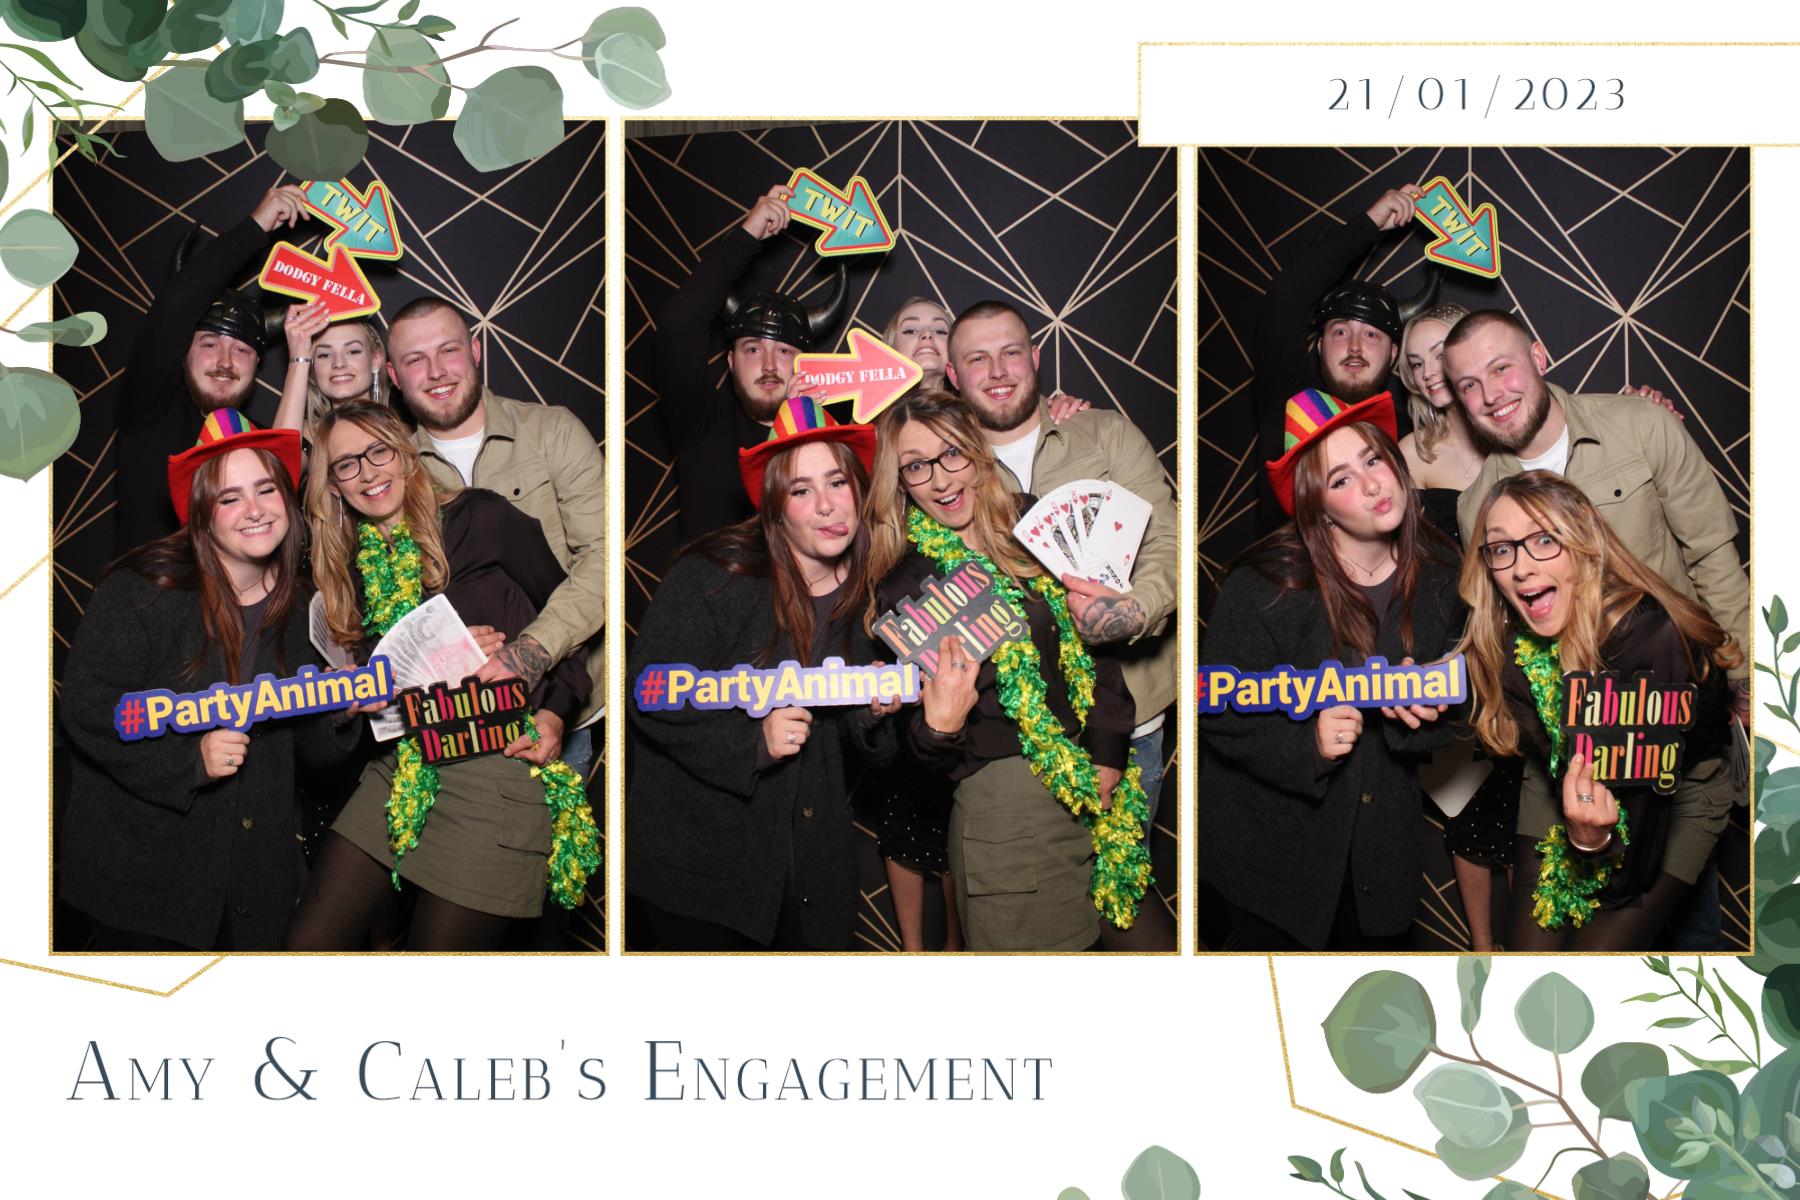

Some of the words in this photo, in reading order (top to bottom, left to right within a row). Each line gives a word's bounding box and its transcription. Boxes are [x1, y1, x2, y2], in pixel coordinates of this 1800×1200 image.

[320, 182, 387, 243] TWIT
[804, 187, 875, 238] TWIT
[1430, 195, 1490, 257] TWIT
[273, 260, 323, 288] DODGY
[321, 279, 366, 306] FELLA
[860, 366, 906, 383] FELLA
[880, 562, 991, 657] Fabulous
[120, 660, 388, 735] #PartyAnimal
[404, 682, 526, 728] Fabulous
[640, 663, 914, 712] #PartyAnimal
[1566, 678, 1692, 727] Fabulous
[422, 719, 520, 763] Darling
